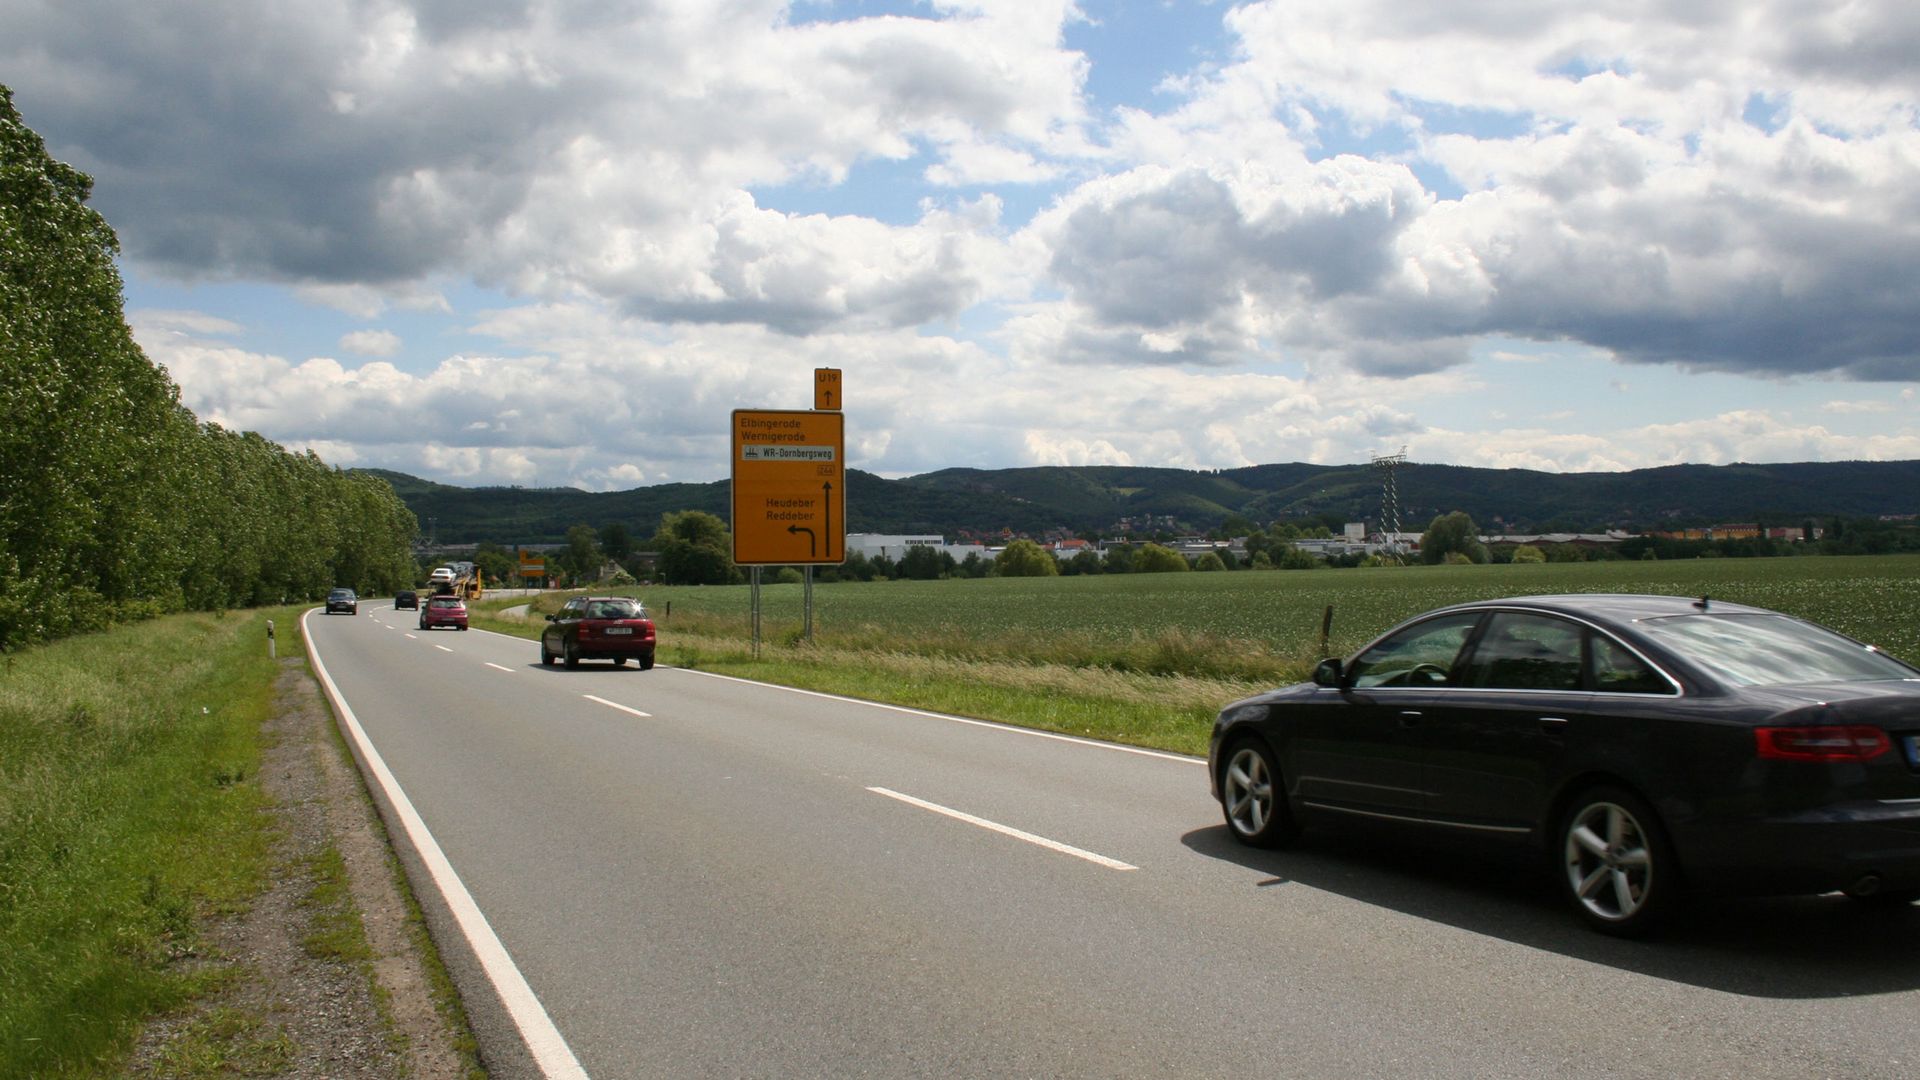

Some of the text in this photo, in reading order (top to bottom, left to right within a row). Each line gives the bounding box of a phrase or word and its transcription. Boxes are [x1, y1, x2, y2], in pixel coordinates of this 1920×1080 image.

[818, 373, 837, 383] U19
[740, 417, 801, 430] Elbingerode
[741, 430, 806, 443] Wernigerode
[763, 447, 832, 460] WR-Dornbergsweg
[766, 498, 815, 508] Heudeber
[766, 510, 815, 521] Reddeber
